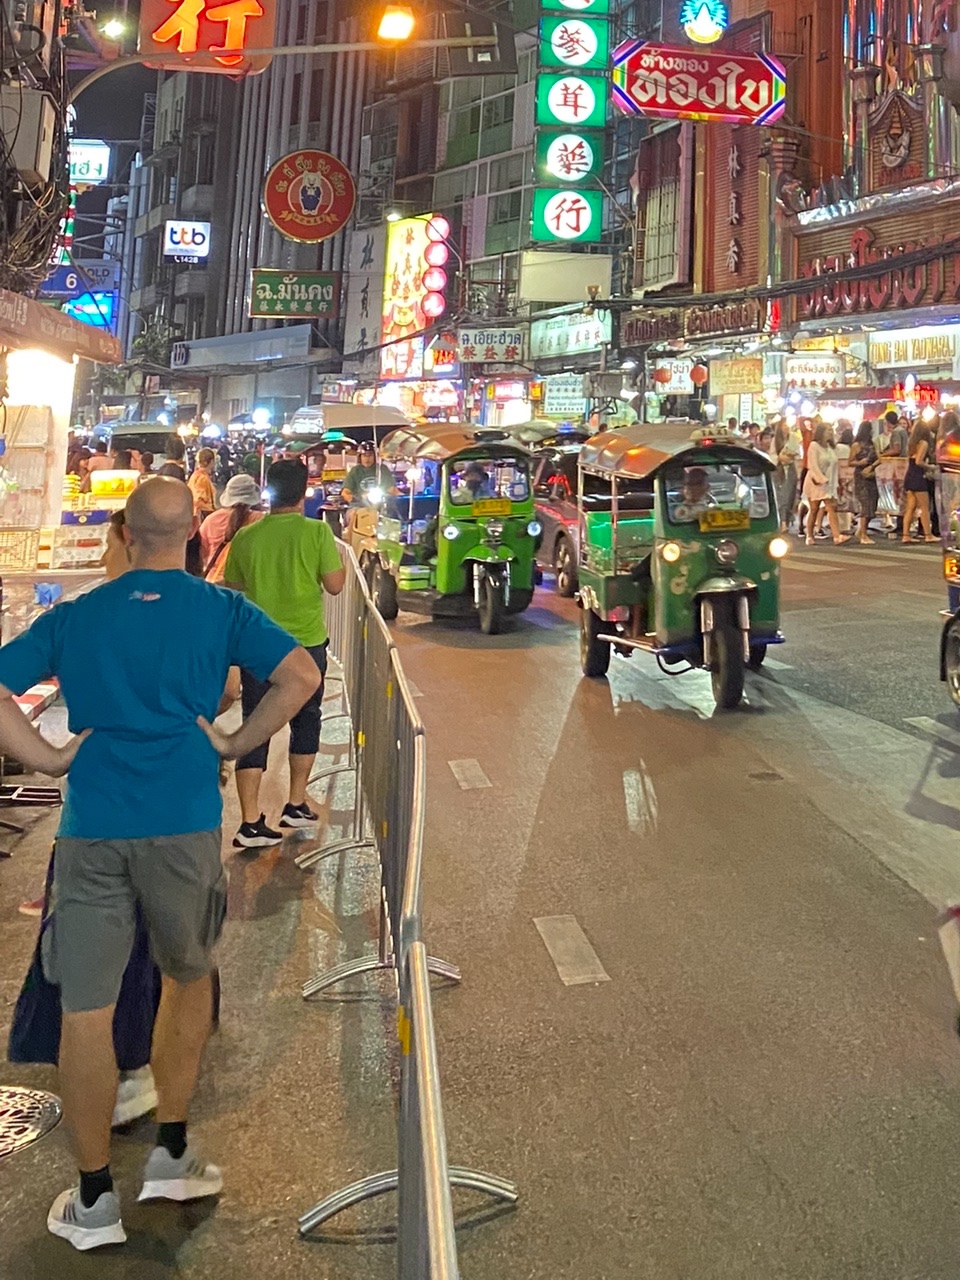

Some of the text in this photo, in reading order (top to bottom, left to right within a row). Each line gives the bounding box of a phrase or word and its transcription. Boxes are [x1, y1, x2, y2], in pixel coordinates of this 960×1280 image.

[639, 50, 710, 74] ห้างทอง
[630, 61, 770, 113] ทองใบ
[169, 226, 206, 246] ttb
[179, 255, 199, 264] 1428
[255, 273, 334, 301] ฉ.มั่นคง
